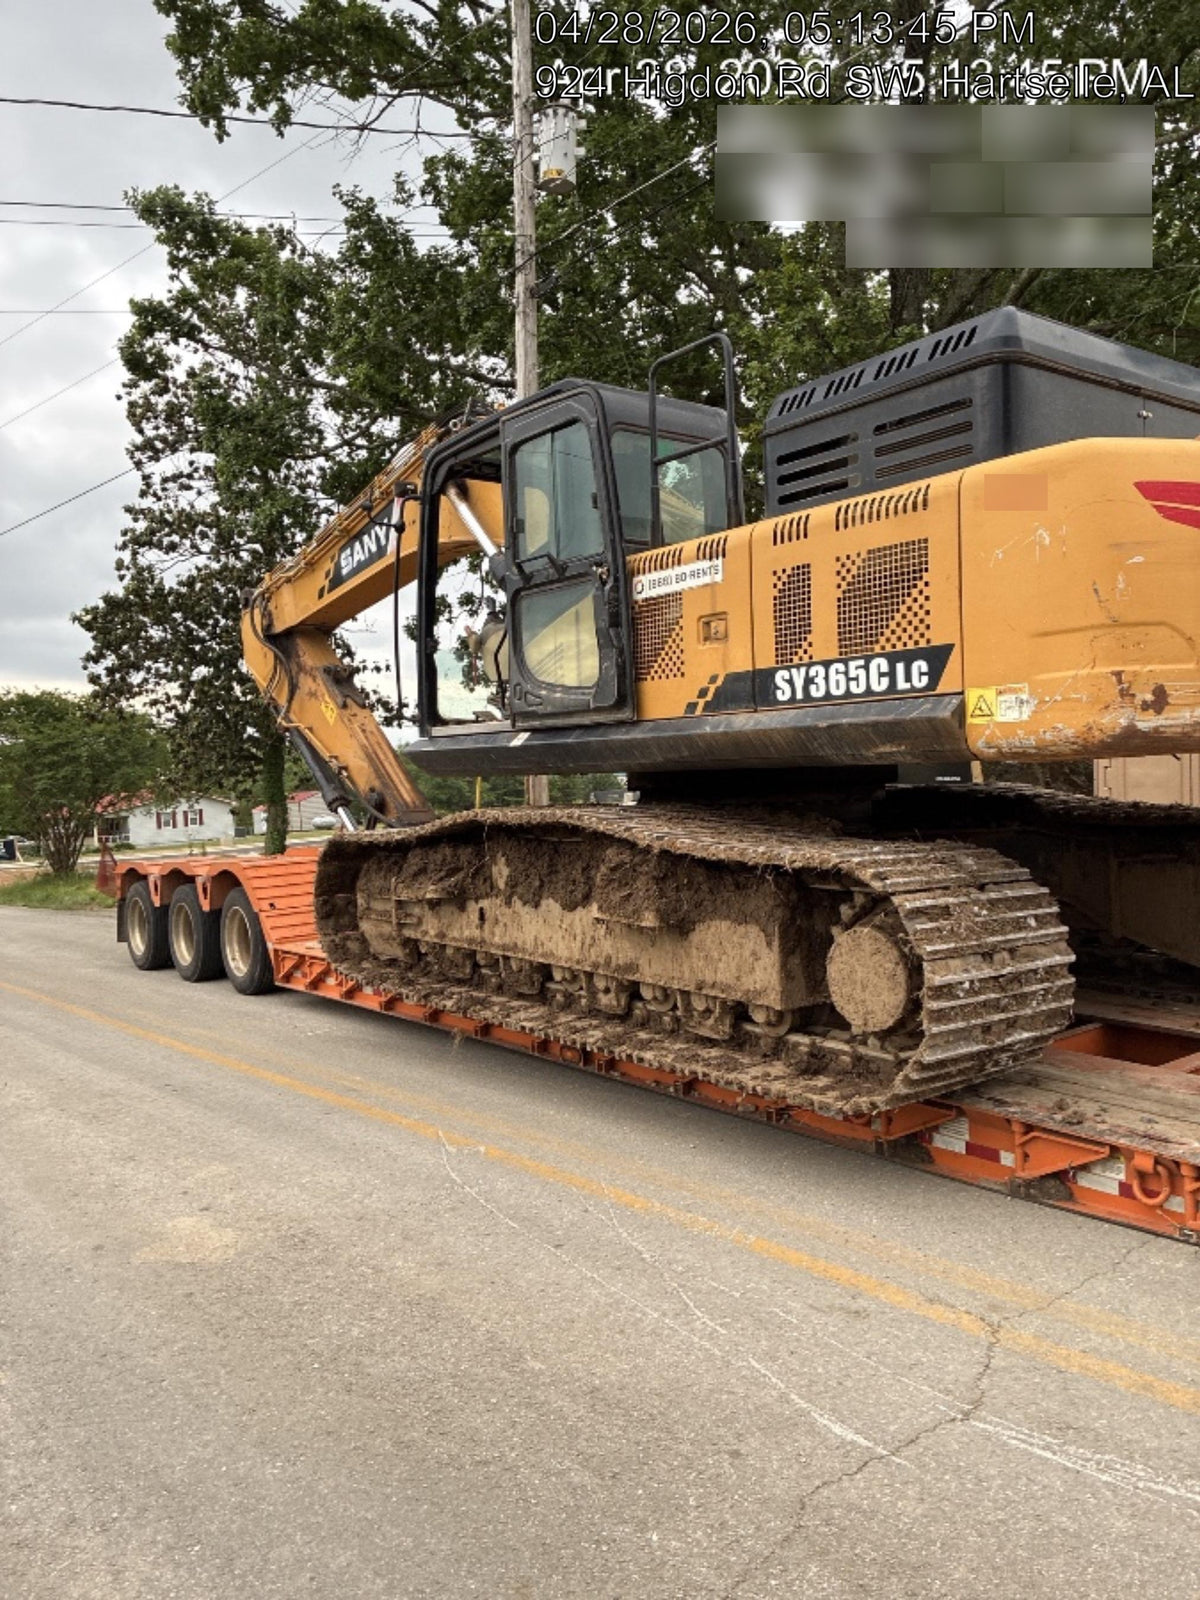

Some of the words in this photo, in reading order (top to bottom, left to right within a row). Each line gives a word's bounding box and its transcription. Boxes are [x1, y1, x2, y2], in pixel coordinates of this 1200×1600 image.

[340, 516, 389, 577] SANY
[774, 656, 890, 702] SY365C
[895, 659, 930, 691] LC
